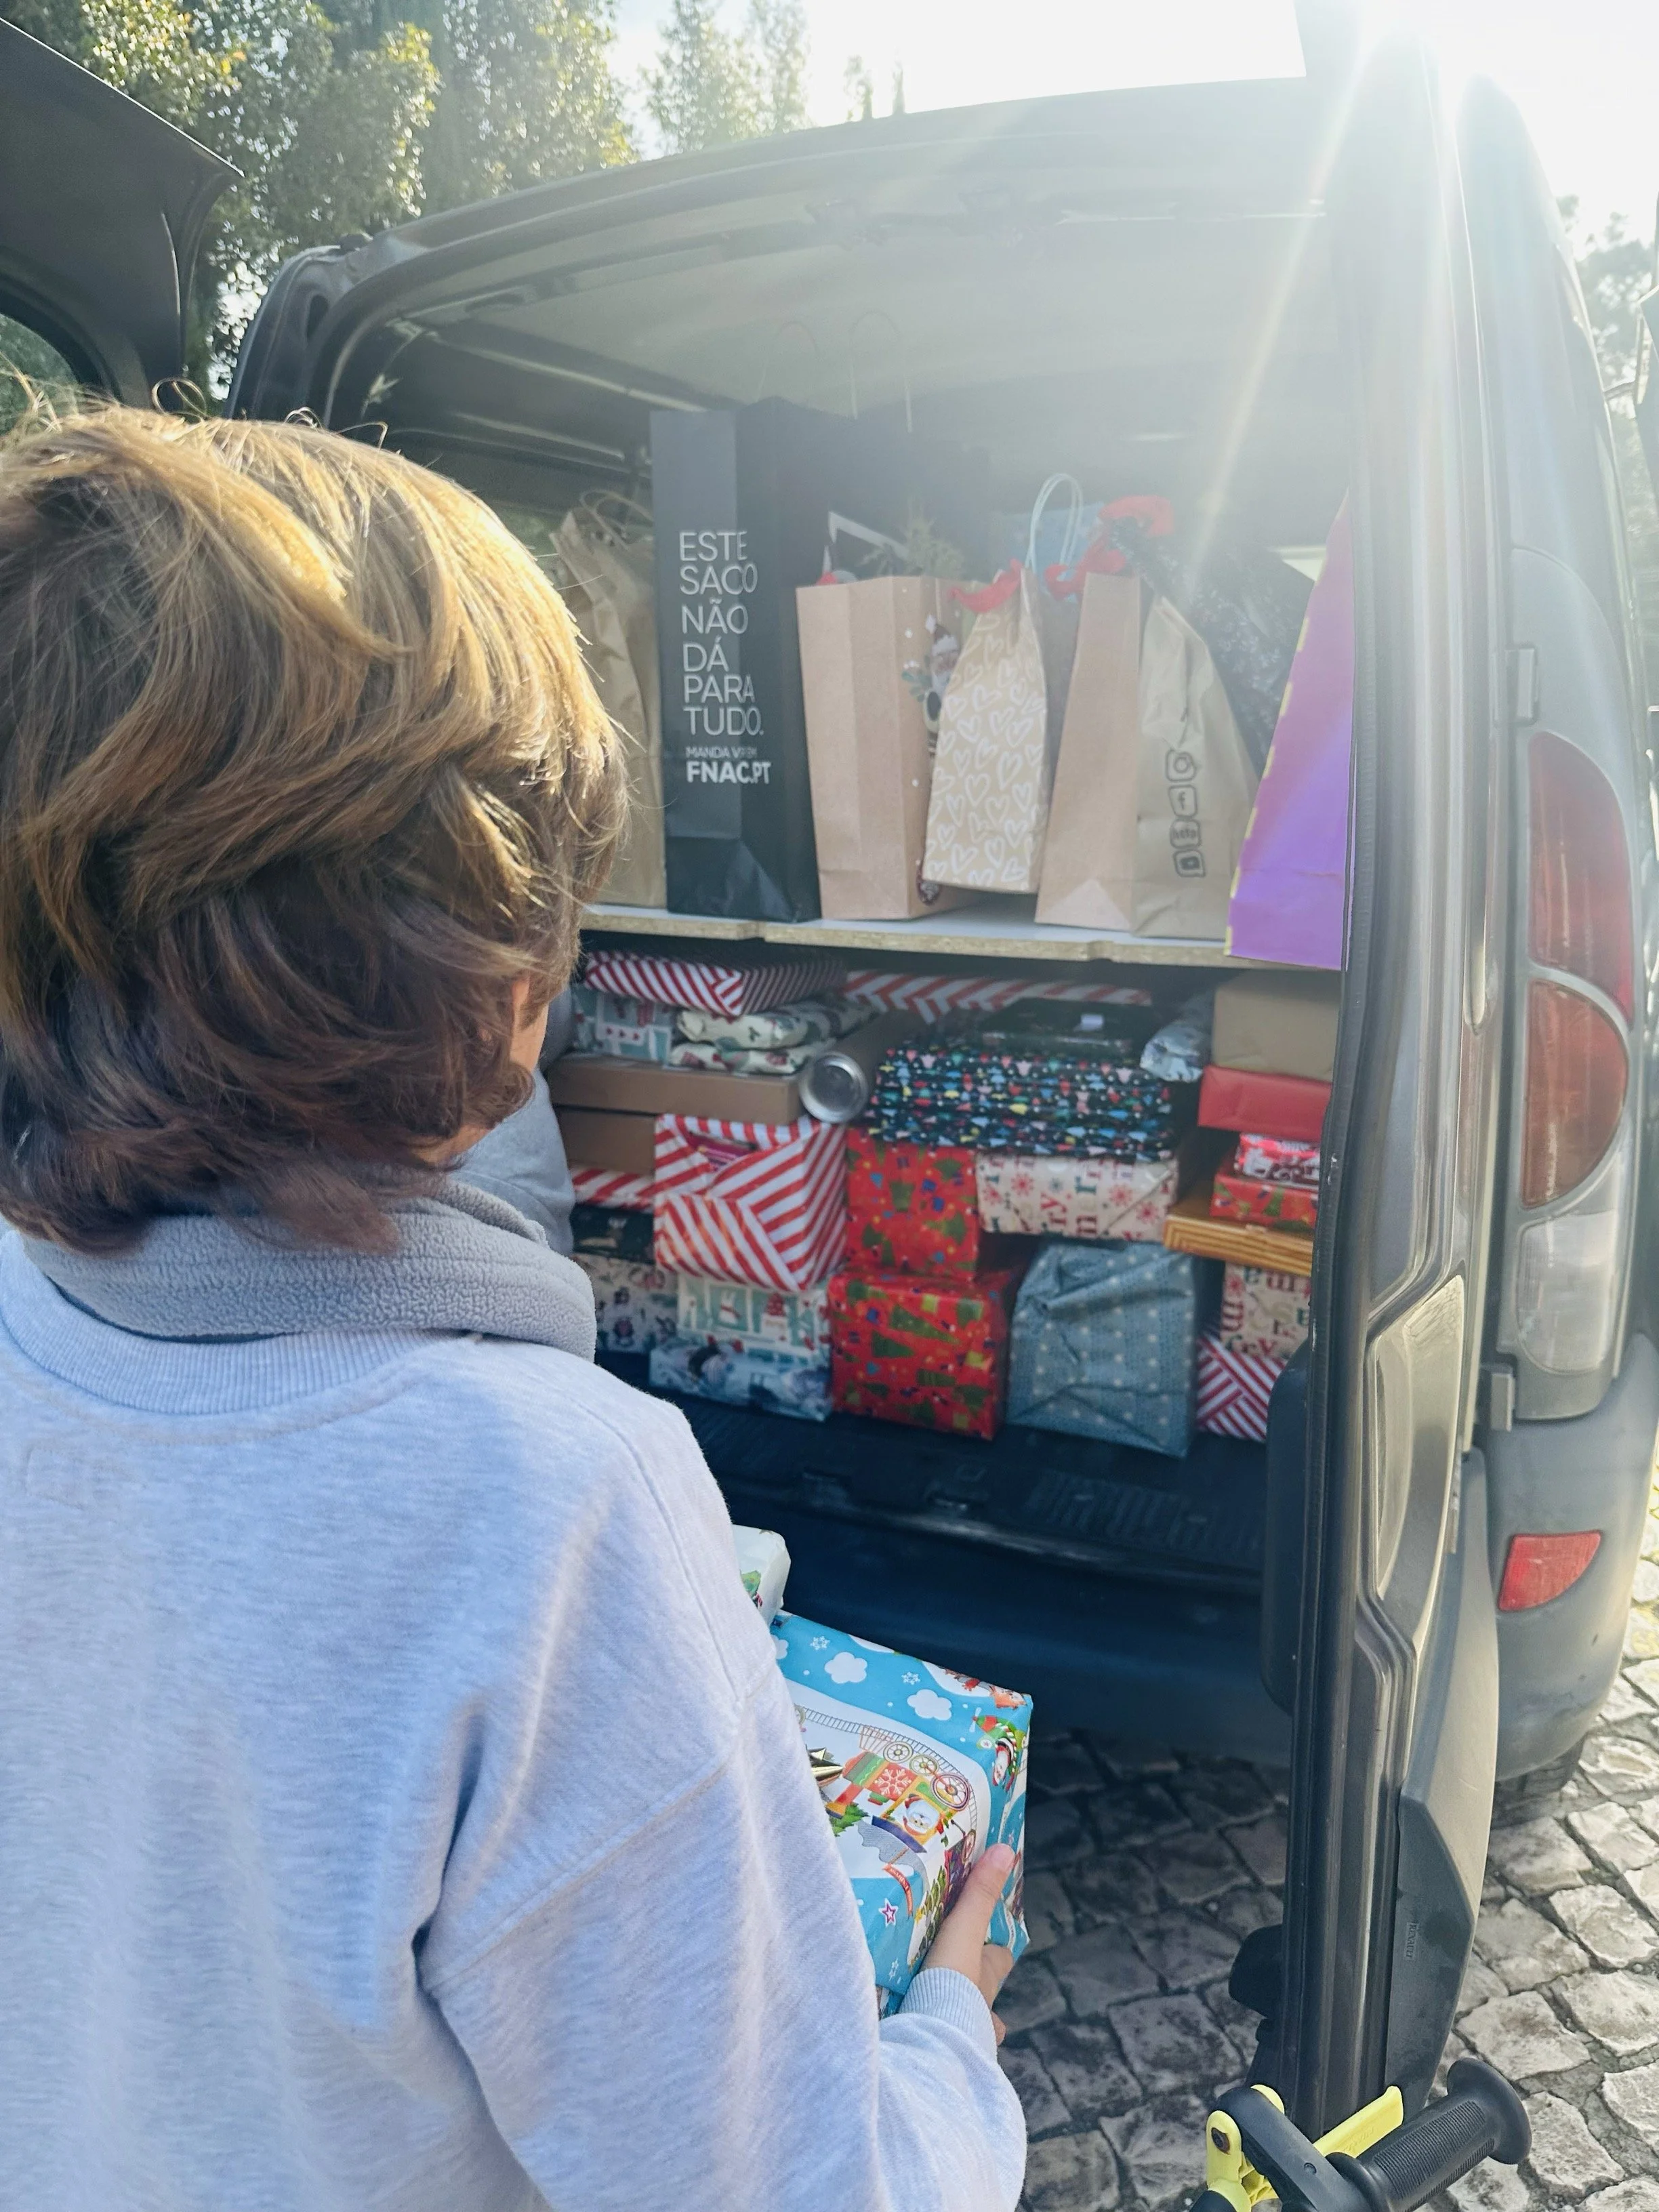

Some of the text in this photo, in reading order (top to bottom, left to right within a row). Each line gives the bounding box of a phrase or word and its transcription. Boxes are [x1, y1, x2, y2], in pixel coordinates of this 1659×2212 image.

[680, 531, 747, 561] ESTE
[680, 563, 758, 595] SACO
[682, 598, 748, 634] NÃO
[683, 636, 729, 672] DÁ
[684, 674, 755, 703] PARA
[683, 706, 764, 736] TUDO.
[687, 760, 772, 783] FNAC.PT
